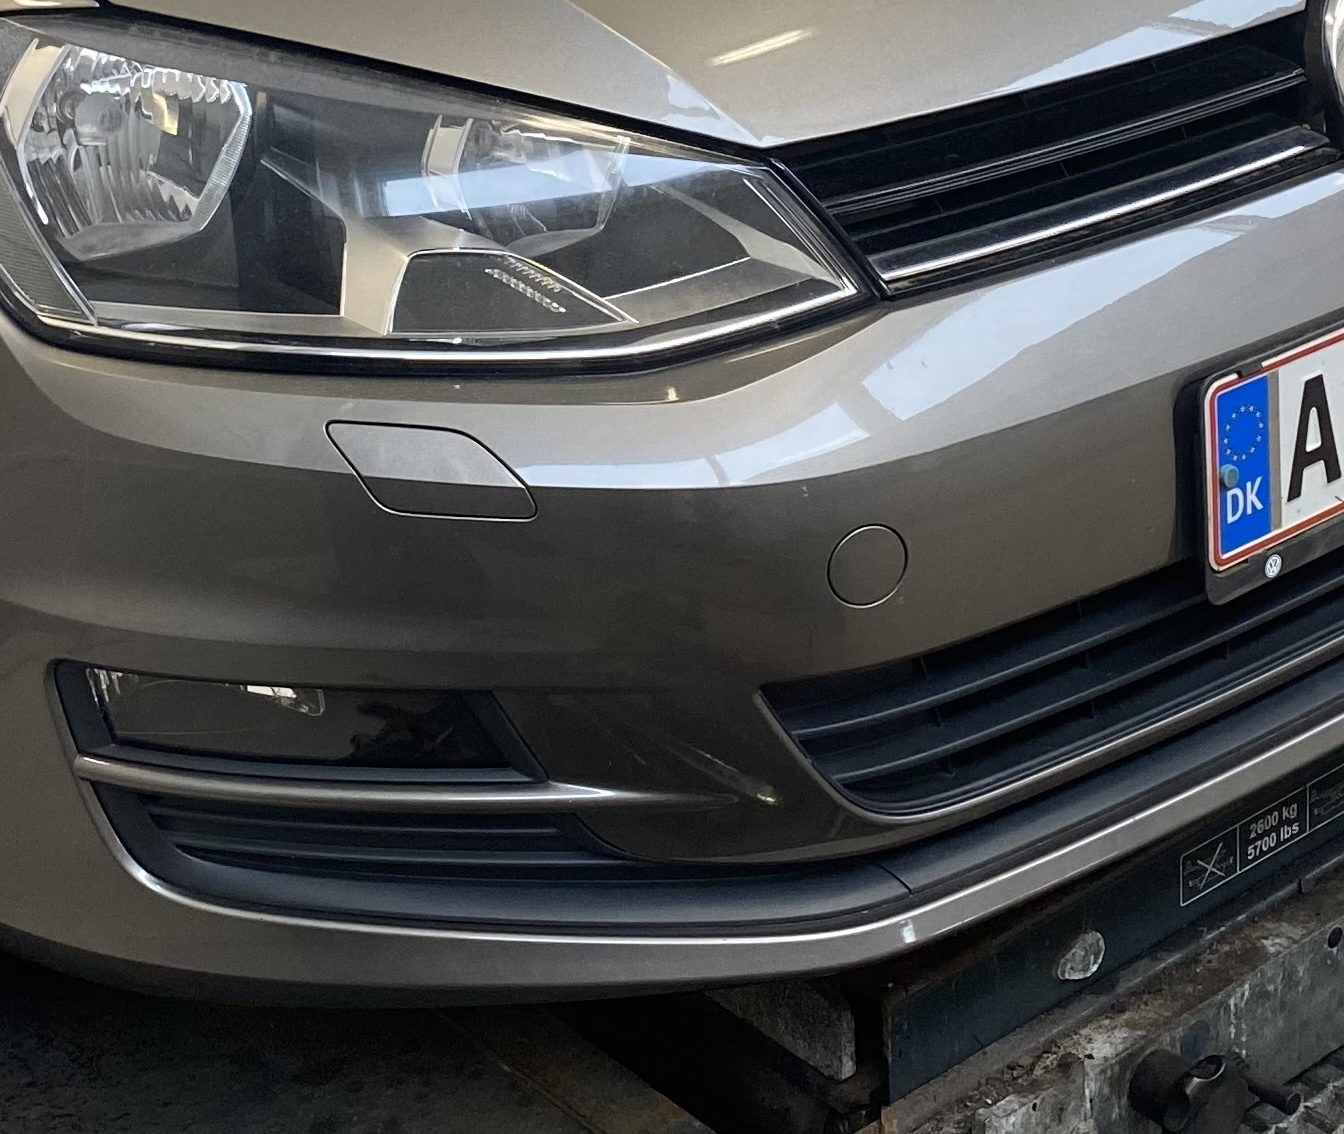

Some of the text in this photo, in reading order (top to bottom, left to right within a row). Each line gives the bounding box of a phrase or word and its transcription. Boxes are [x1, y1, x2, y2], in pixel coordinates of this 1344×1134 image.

[1227, 475, 1264, 524] DK
[1249, 803, 1297, 839] 2600 kg
[1247, 822, 1299, 859] 5700 lbs
